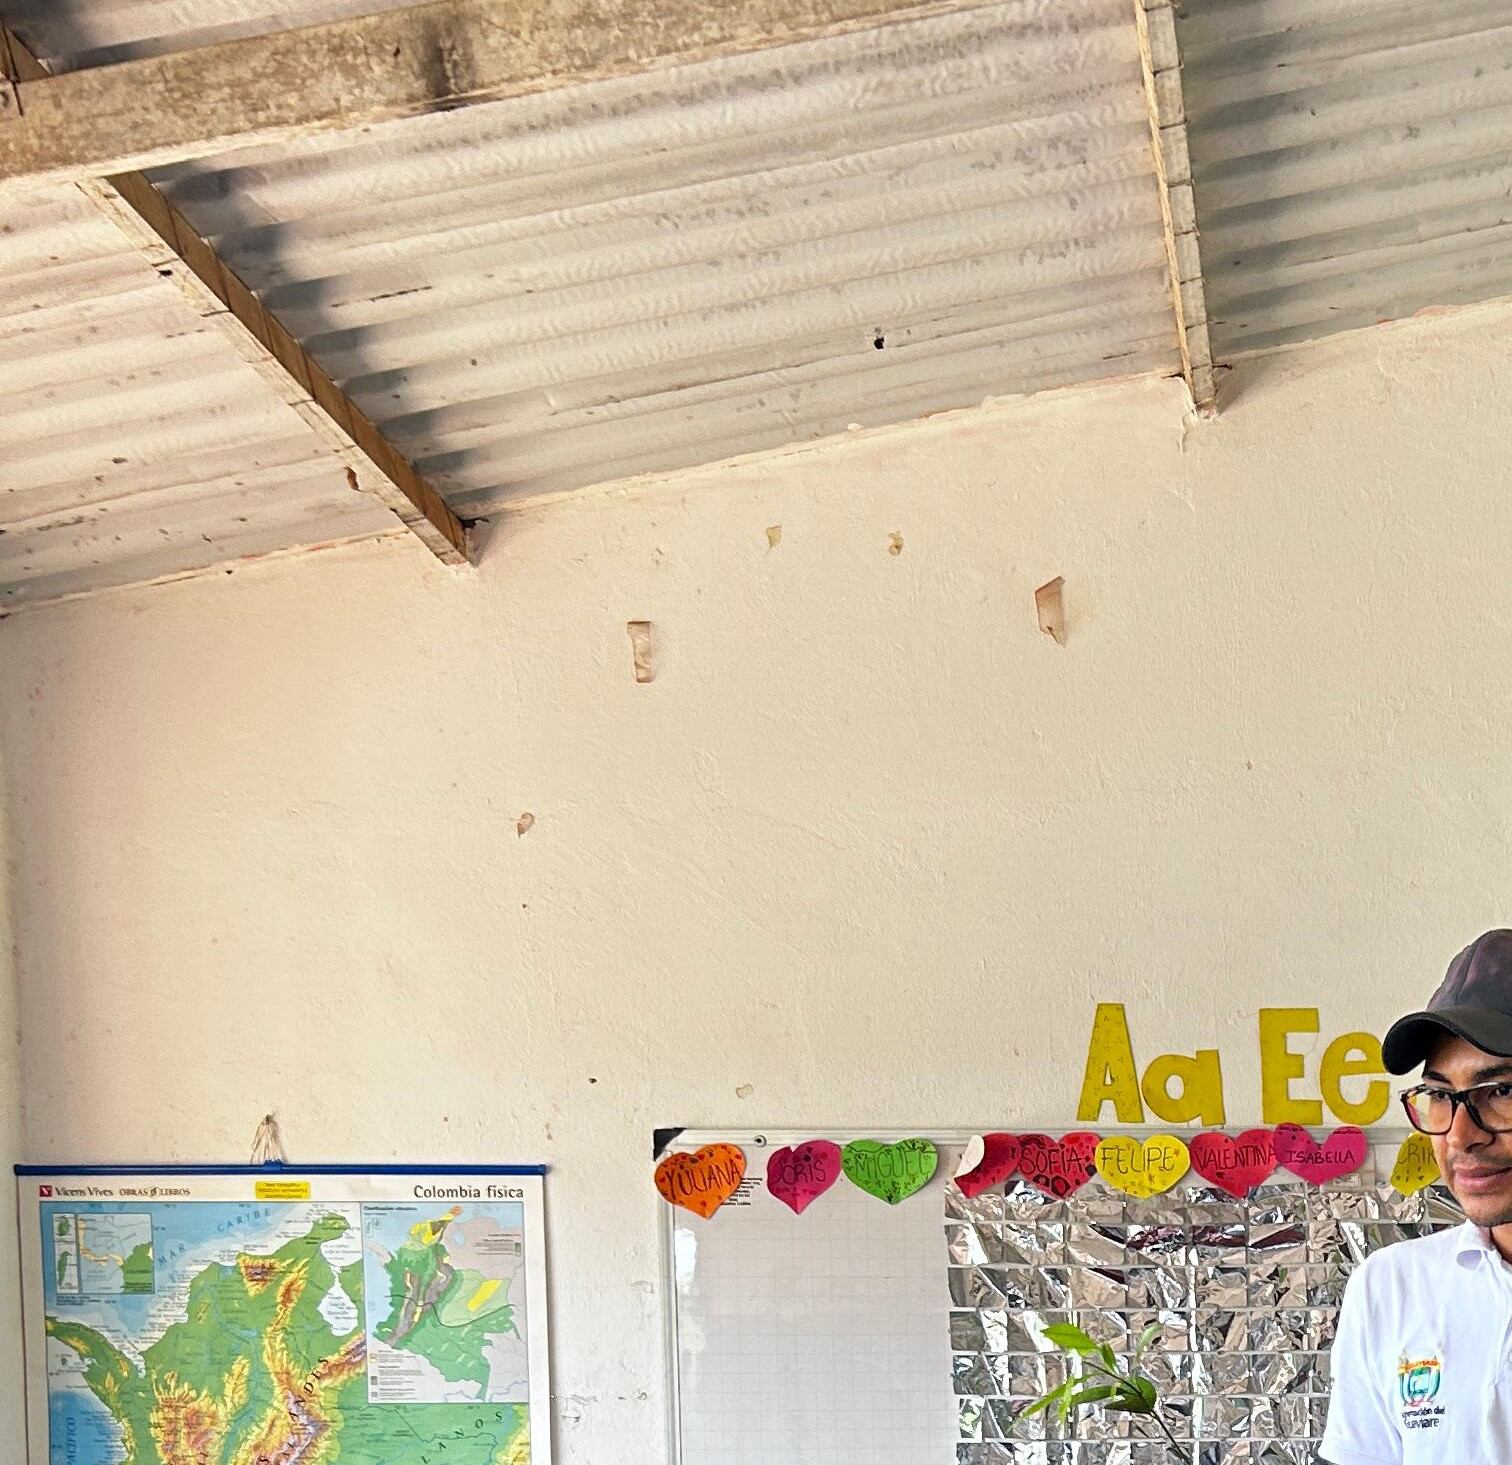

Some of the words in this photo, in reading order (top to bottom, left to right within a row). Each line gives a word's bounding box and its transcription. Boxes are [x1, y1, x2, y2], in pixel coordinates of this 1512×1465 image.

[1076, 1002, 1226, 1126] Aa
[1258, 1007, 1390, 1126] Ee
[1101, 1146, 1176, 1175] FELIPE
[1195, 1142, 1277, 1171] VALENTINA
[1286, 1149, 1356, 1166] ISABELLA
[413, 1184, 481, 1199] Colombia
[664, 1159, 742, 1198] YULIANA
[216, 1207, 272, 1234] CARIBE
